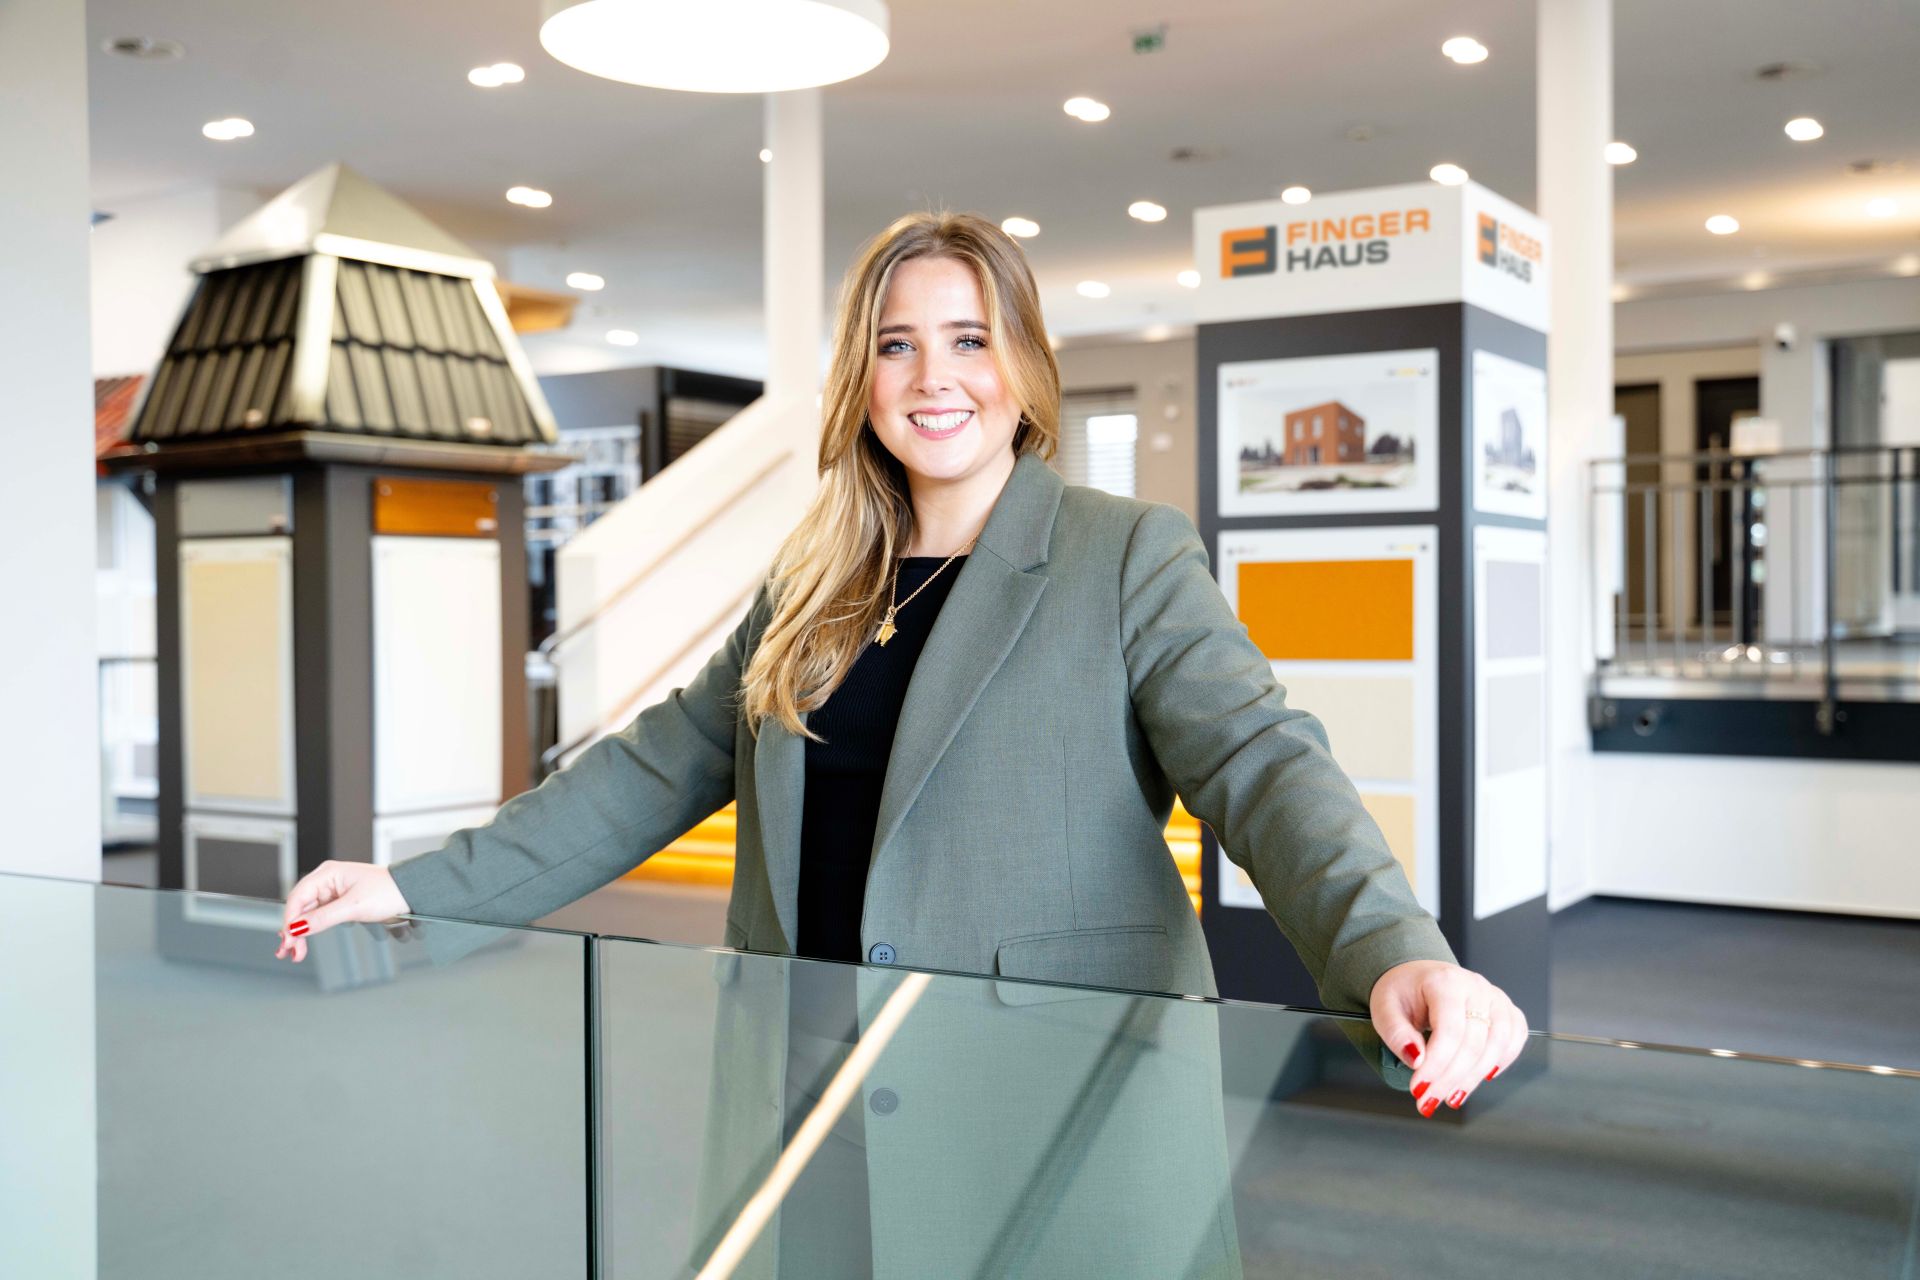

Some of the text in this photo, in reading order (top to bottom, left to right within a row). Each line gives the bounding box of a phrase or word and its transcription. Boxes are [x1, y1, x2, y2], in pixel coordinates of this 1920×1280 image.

[1286, 208, 1430, 246] FINGER
[1500, 222, 1542, 263] FINGER
[1286, 239, 1389, 272] HAUS
[1499, 248, 1531, 283] HAUS
